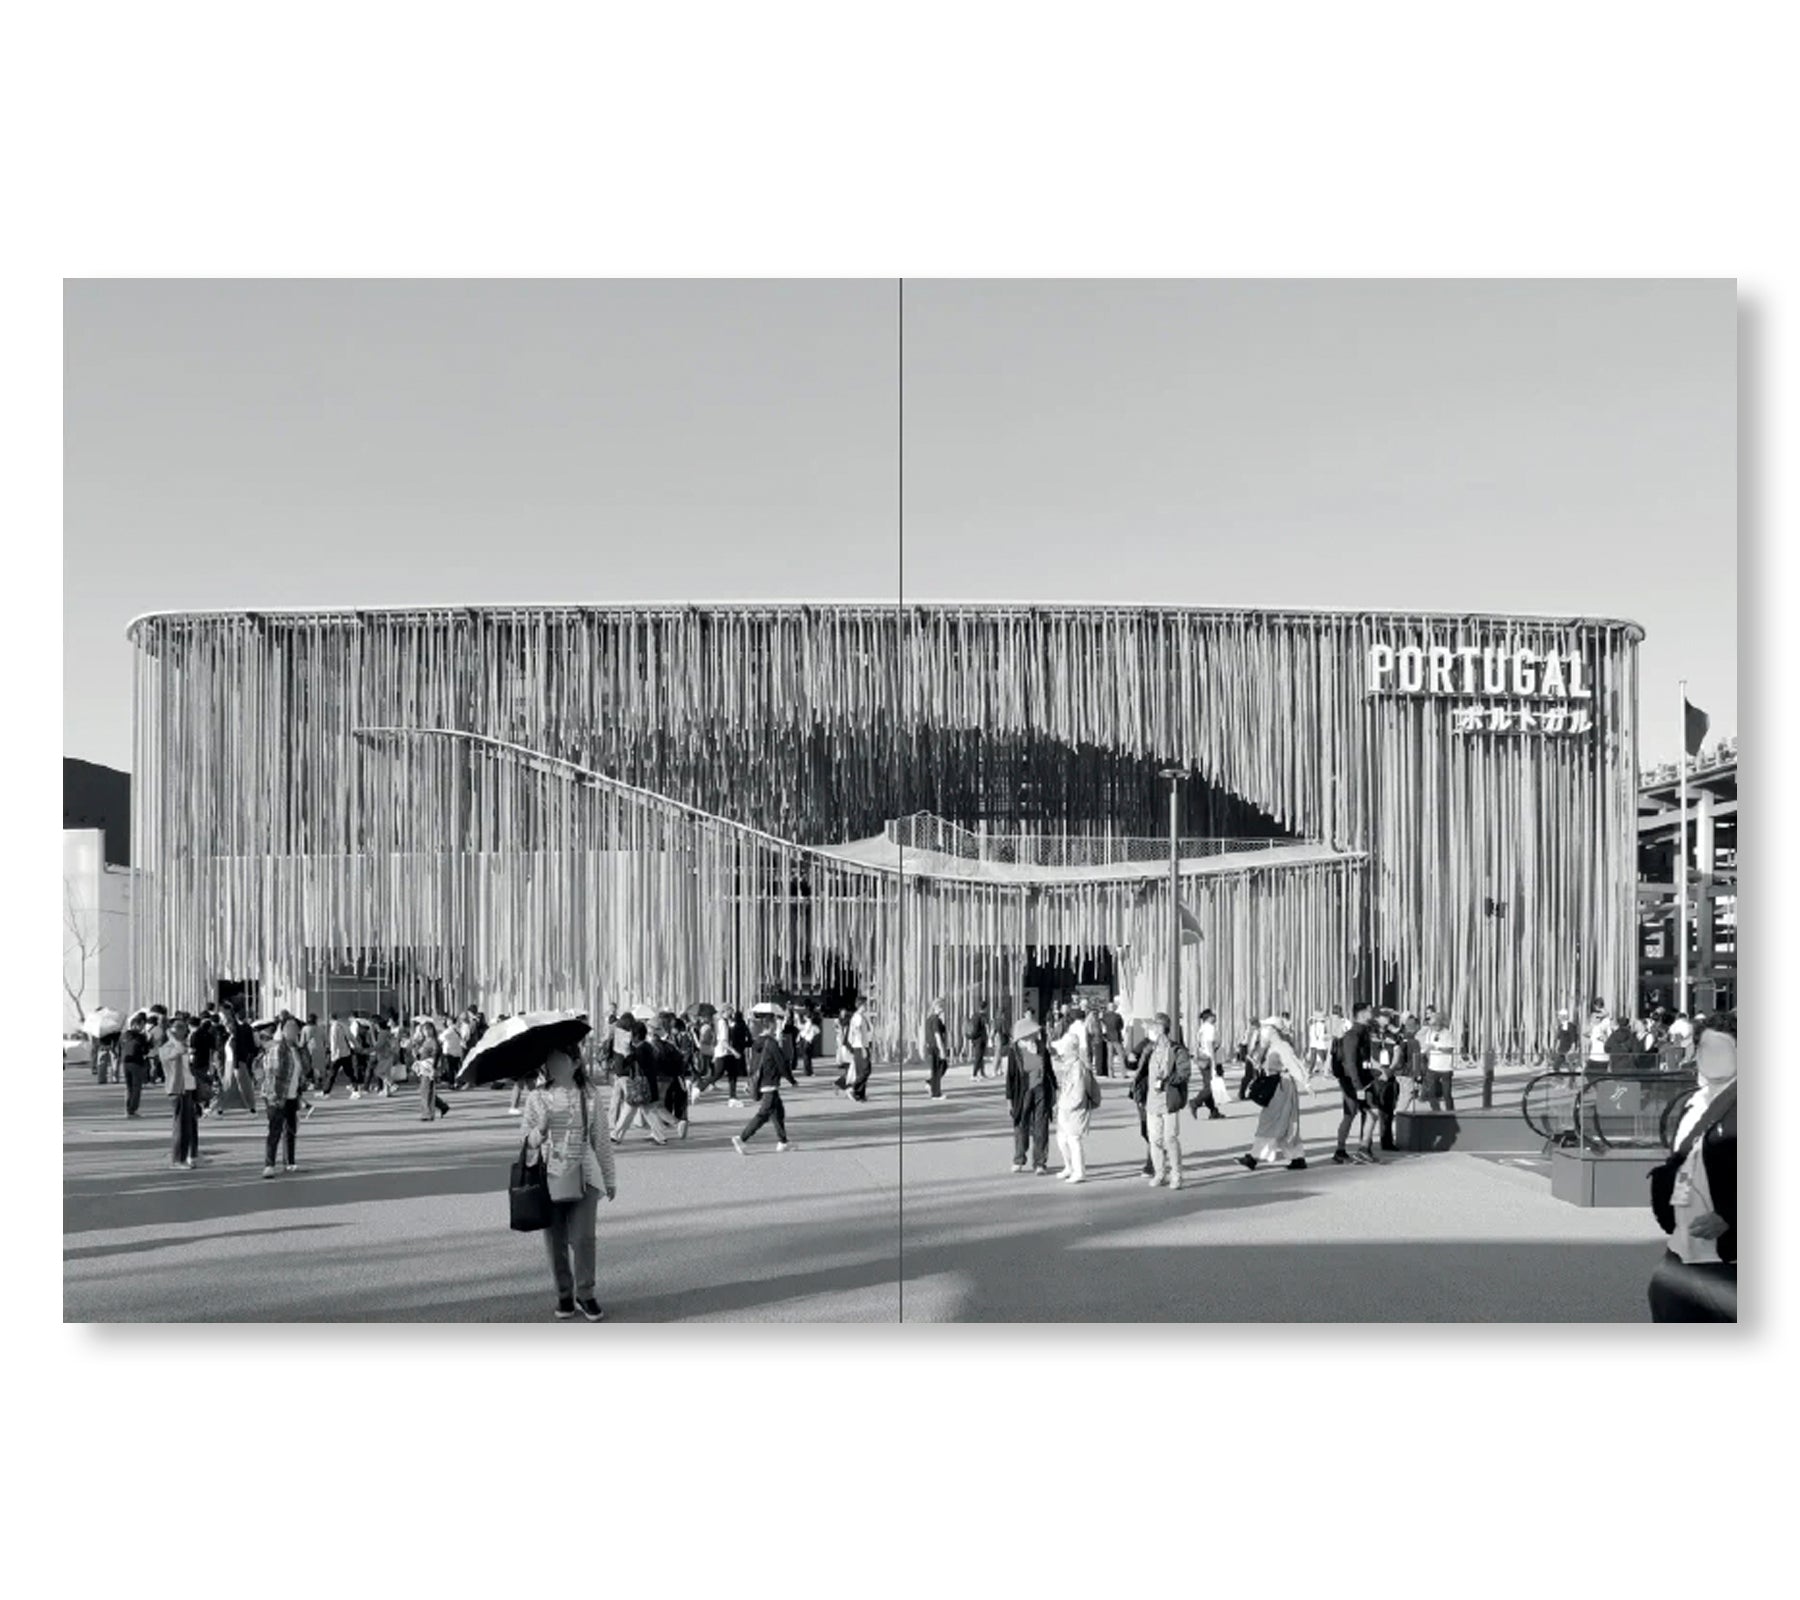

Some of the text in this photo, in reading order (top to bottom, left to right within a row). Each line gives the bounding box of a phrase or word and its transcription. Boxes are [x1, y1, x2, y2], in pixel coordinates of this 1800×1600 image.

[1369, 644, 1591, 698] PORTUGAL
[1459, 704, 1593, 732] ポルトガル
